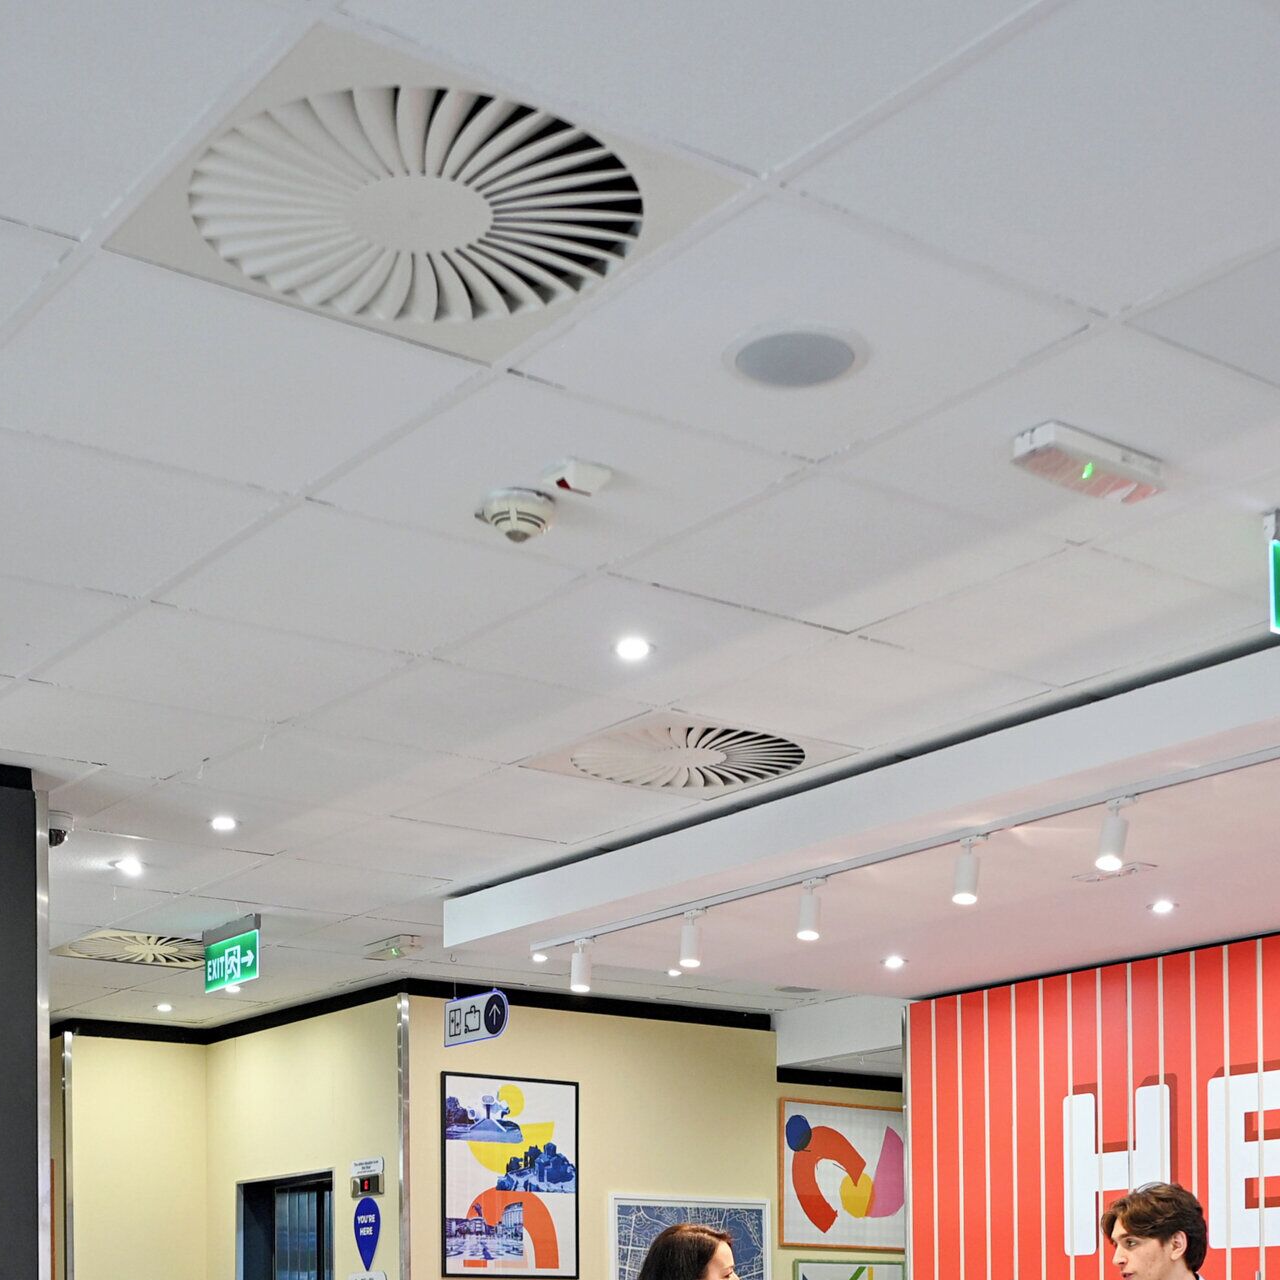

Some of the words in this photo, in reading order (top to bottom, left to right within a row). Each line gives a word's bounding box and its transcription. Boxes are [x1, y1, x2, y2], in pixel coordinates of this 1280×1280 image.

[207, 957, 224, 981] EXIT
[356, 1214, 376, 1224] YOU'RE
[359, 1226, 373, 1236] HERE
